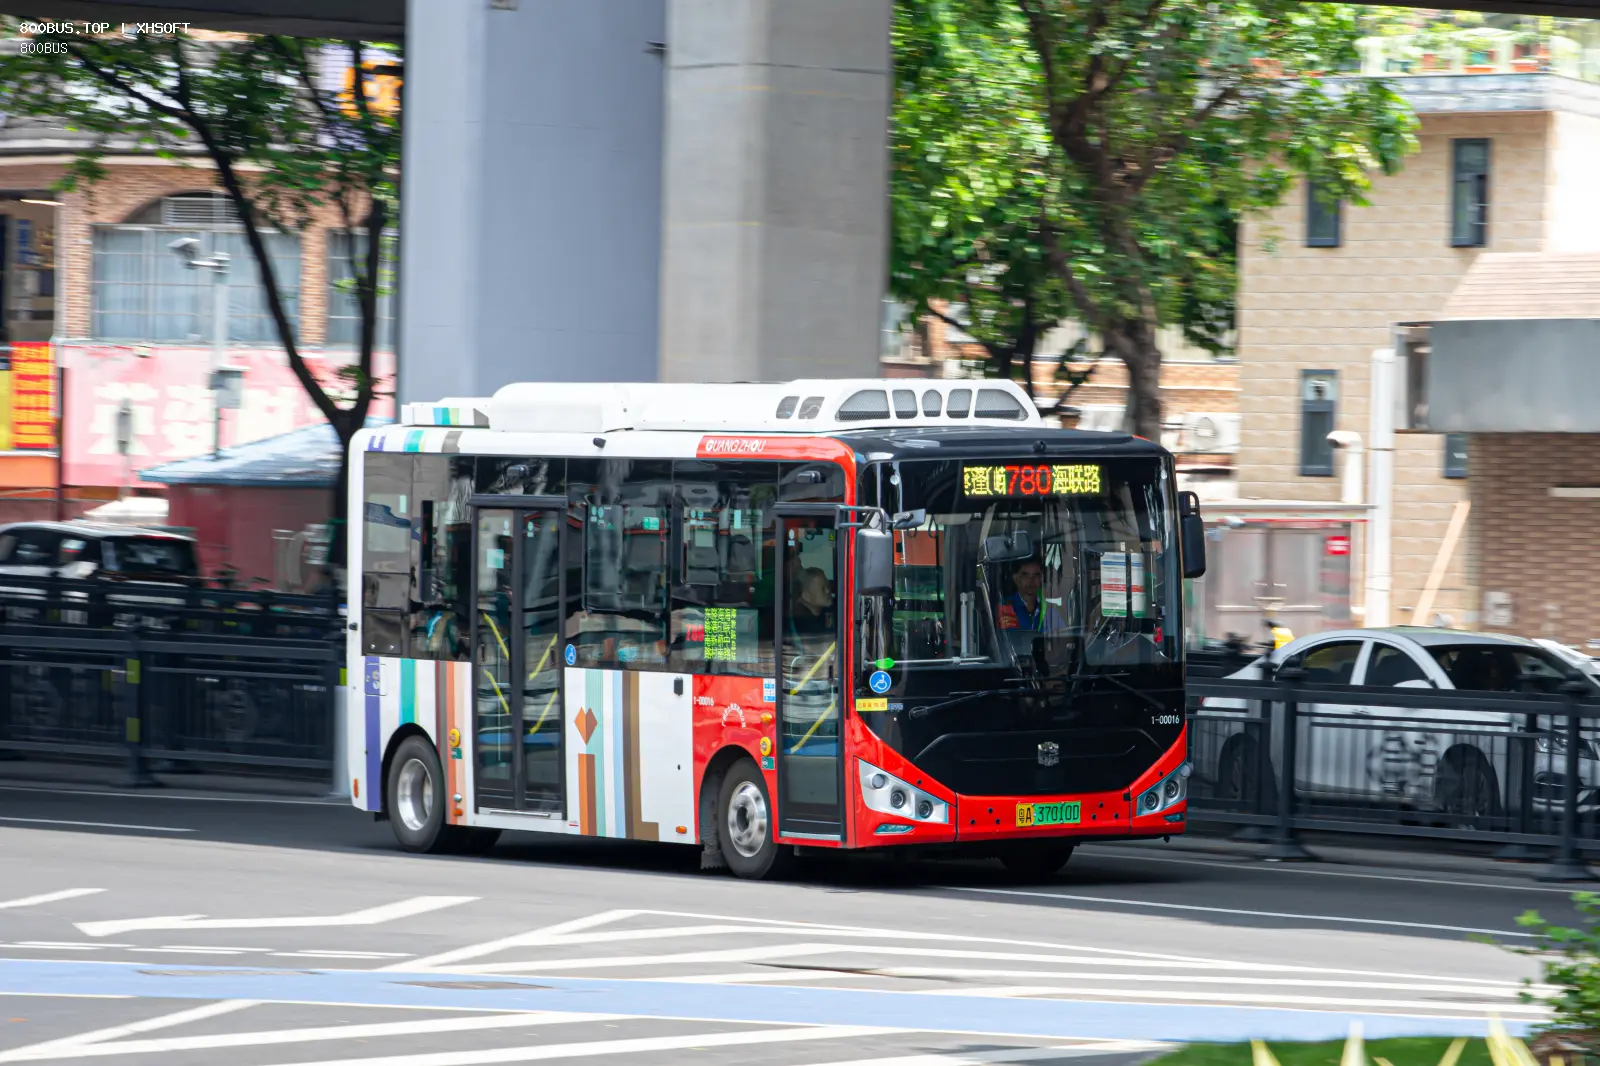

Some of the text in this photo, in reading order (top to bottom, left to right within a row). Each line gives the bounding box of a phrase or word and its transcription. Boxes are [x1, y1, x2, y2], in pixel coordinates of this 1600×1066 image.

[706, 439, 766, 452] GUANGZHOU
[1005, 464, 1052, 496] 780
[1052, 464, 1101, 494] 海联路
[1151, 715, 1180, 725] 1-00016
